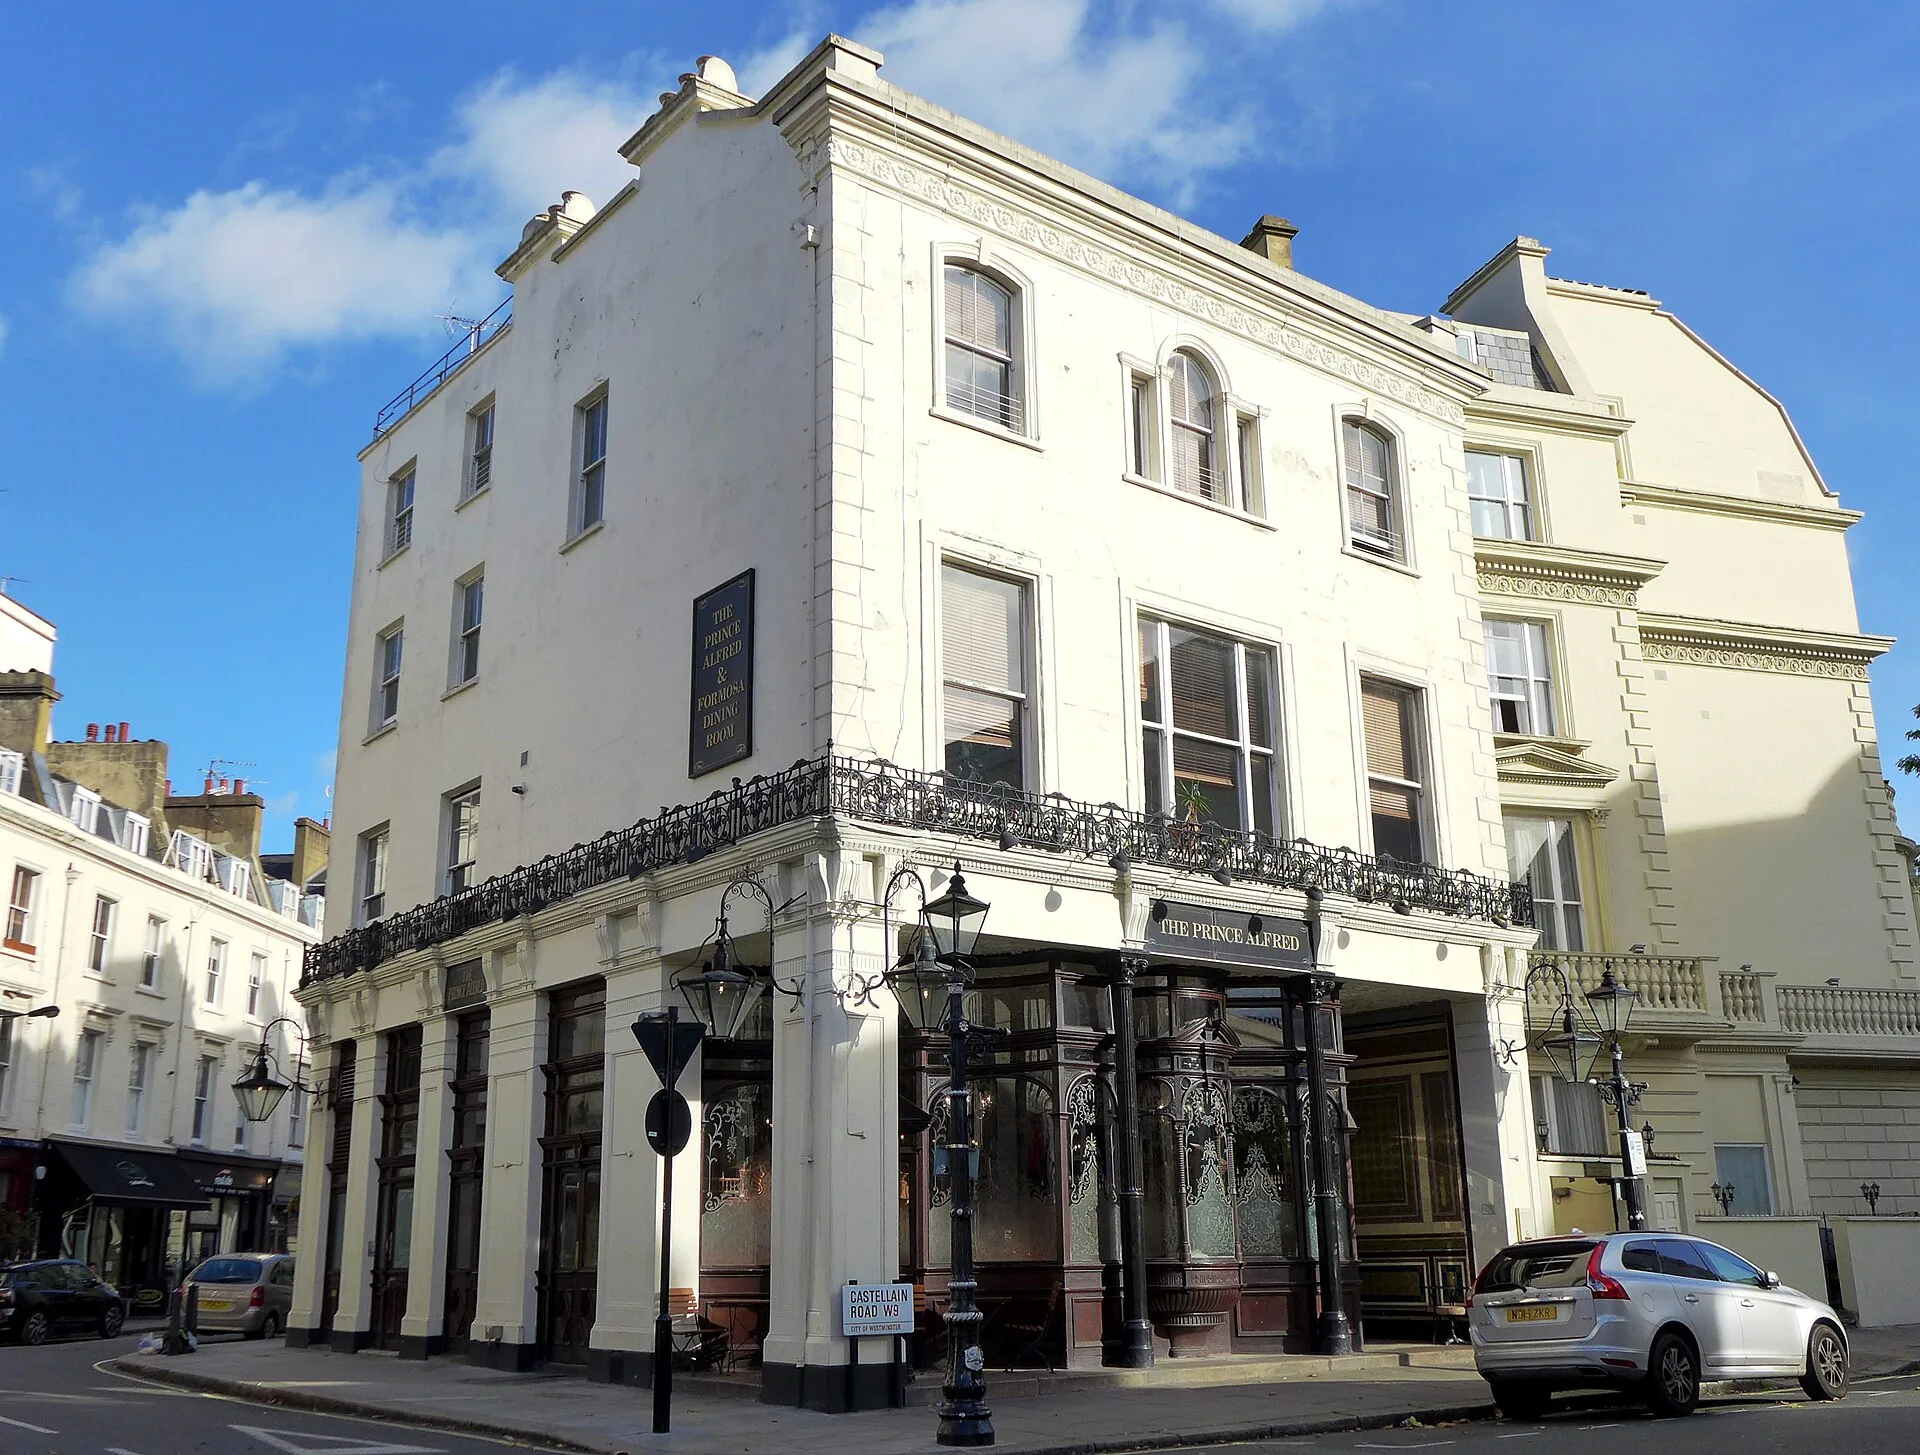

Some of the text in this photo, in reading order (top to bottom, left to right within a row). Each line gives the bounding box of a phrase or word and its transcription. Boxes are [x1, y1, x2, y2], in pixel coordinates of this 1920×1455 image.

[713, 604, 733, 625] THE
[704, 620, 741, 649] PRINCE
[702, 640, 742, 670] ALFRED
[717, 666, 728, 684] &
[697, 679, 745, 712] FORMOSA
[703, 701, 739, 729] DINING
[705, 724, 735, 749] ROOM
[1160, 918, 1300, 951] THE PRINCE ALFRED
[850, 1289, 908, 1303] CASTELLAIN
[850, 1304, 899, 1318] ROAD W9
[1533, 1306, 1551, 1318] ZKR
